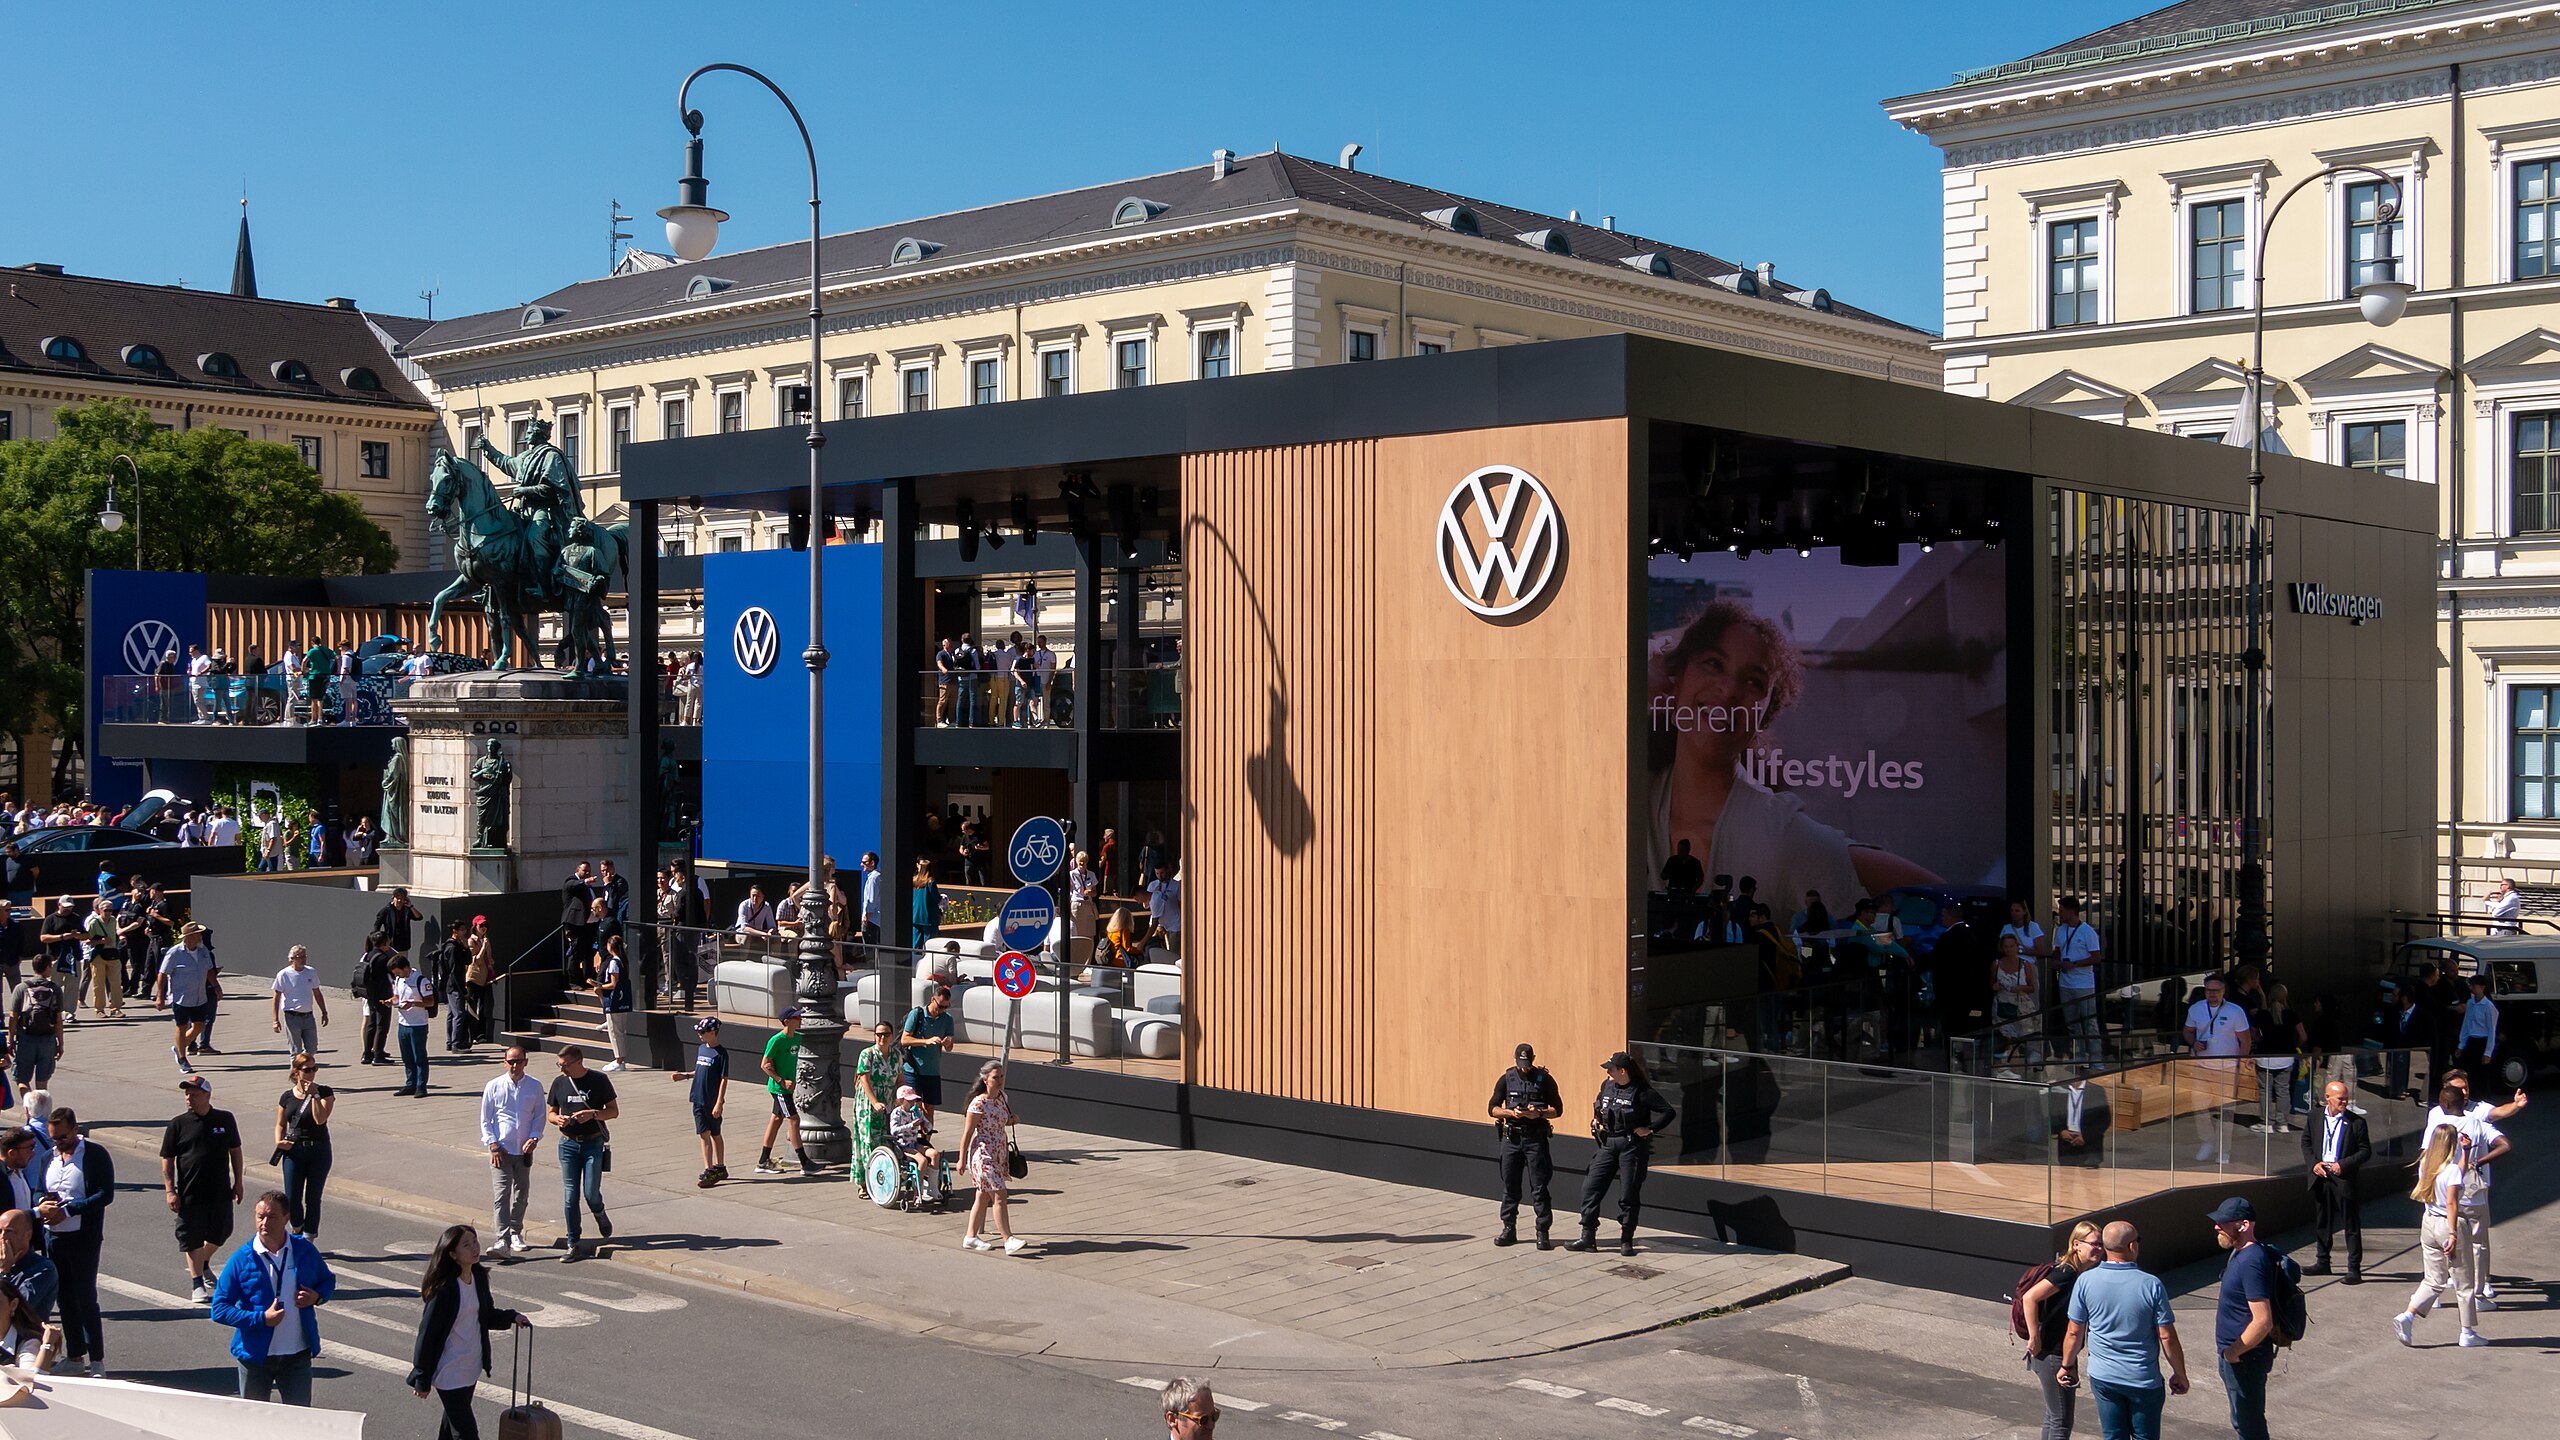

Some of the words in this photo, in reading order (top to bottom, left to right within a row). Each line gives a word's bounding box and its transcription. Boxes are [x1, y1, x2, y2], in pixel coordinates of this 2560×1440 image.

[1438, 465, 1557, 614] VW
[2296, 582, 2383, 626] Volkswagen
[734, 607, 776, 674] VW
[1650, 696, 1763, 733] fferent
[1746, 748, 1924, 798] lifestyles
